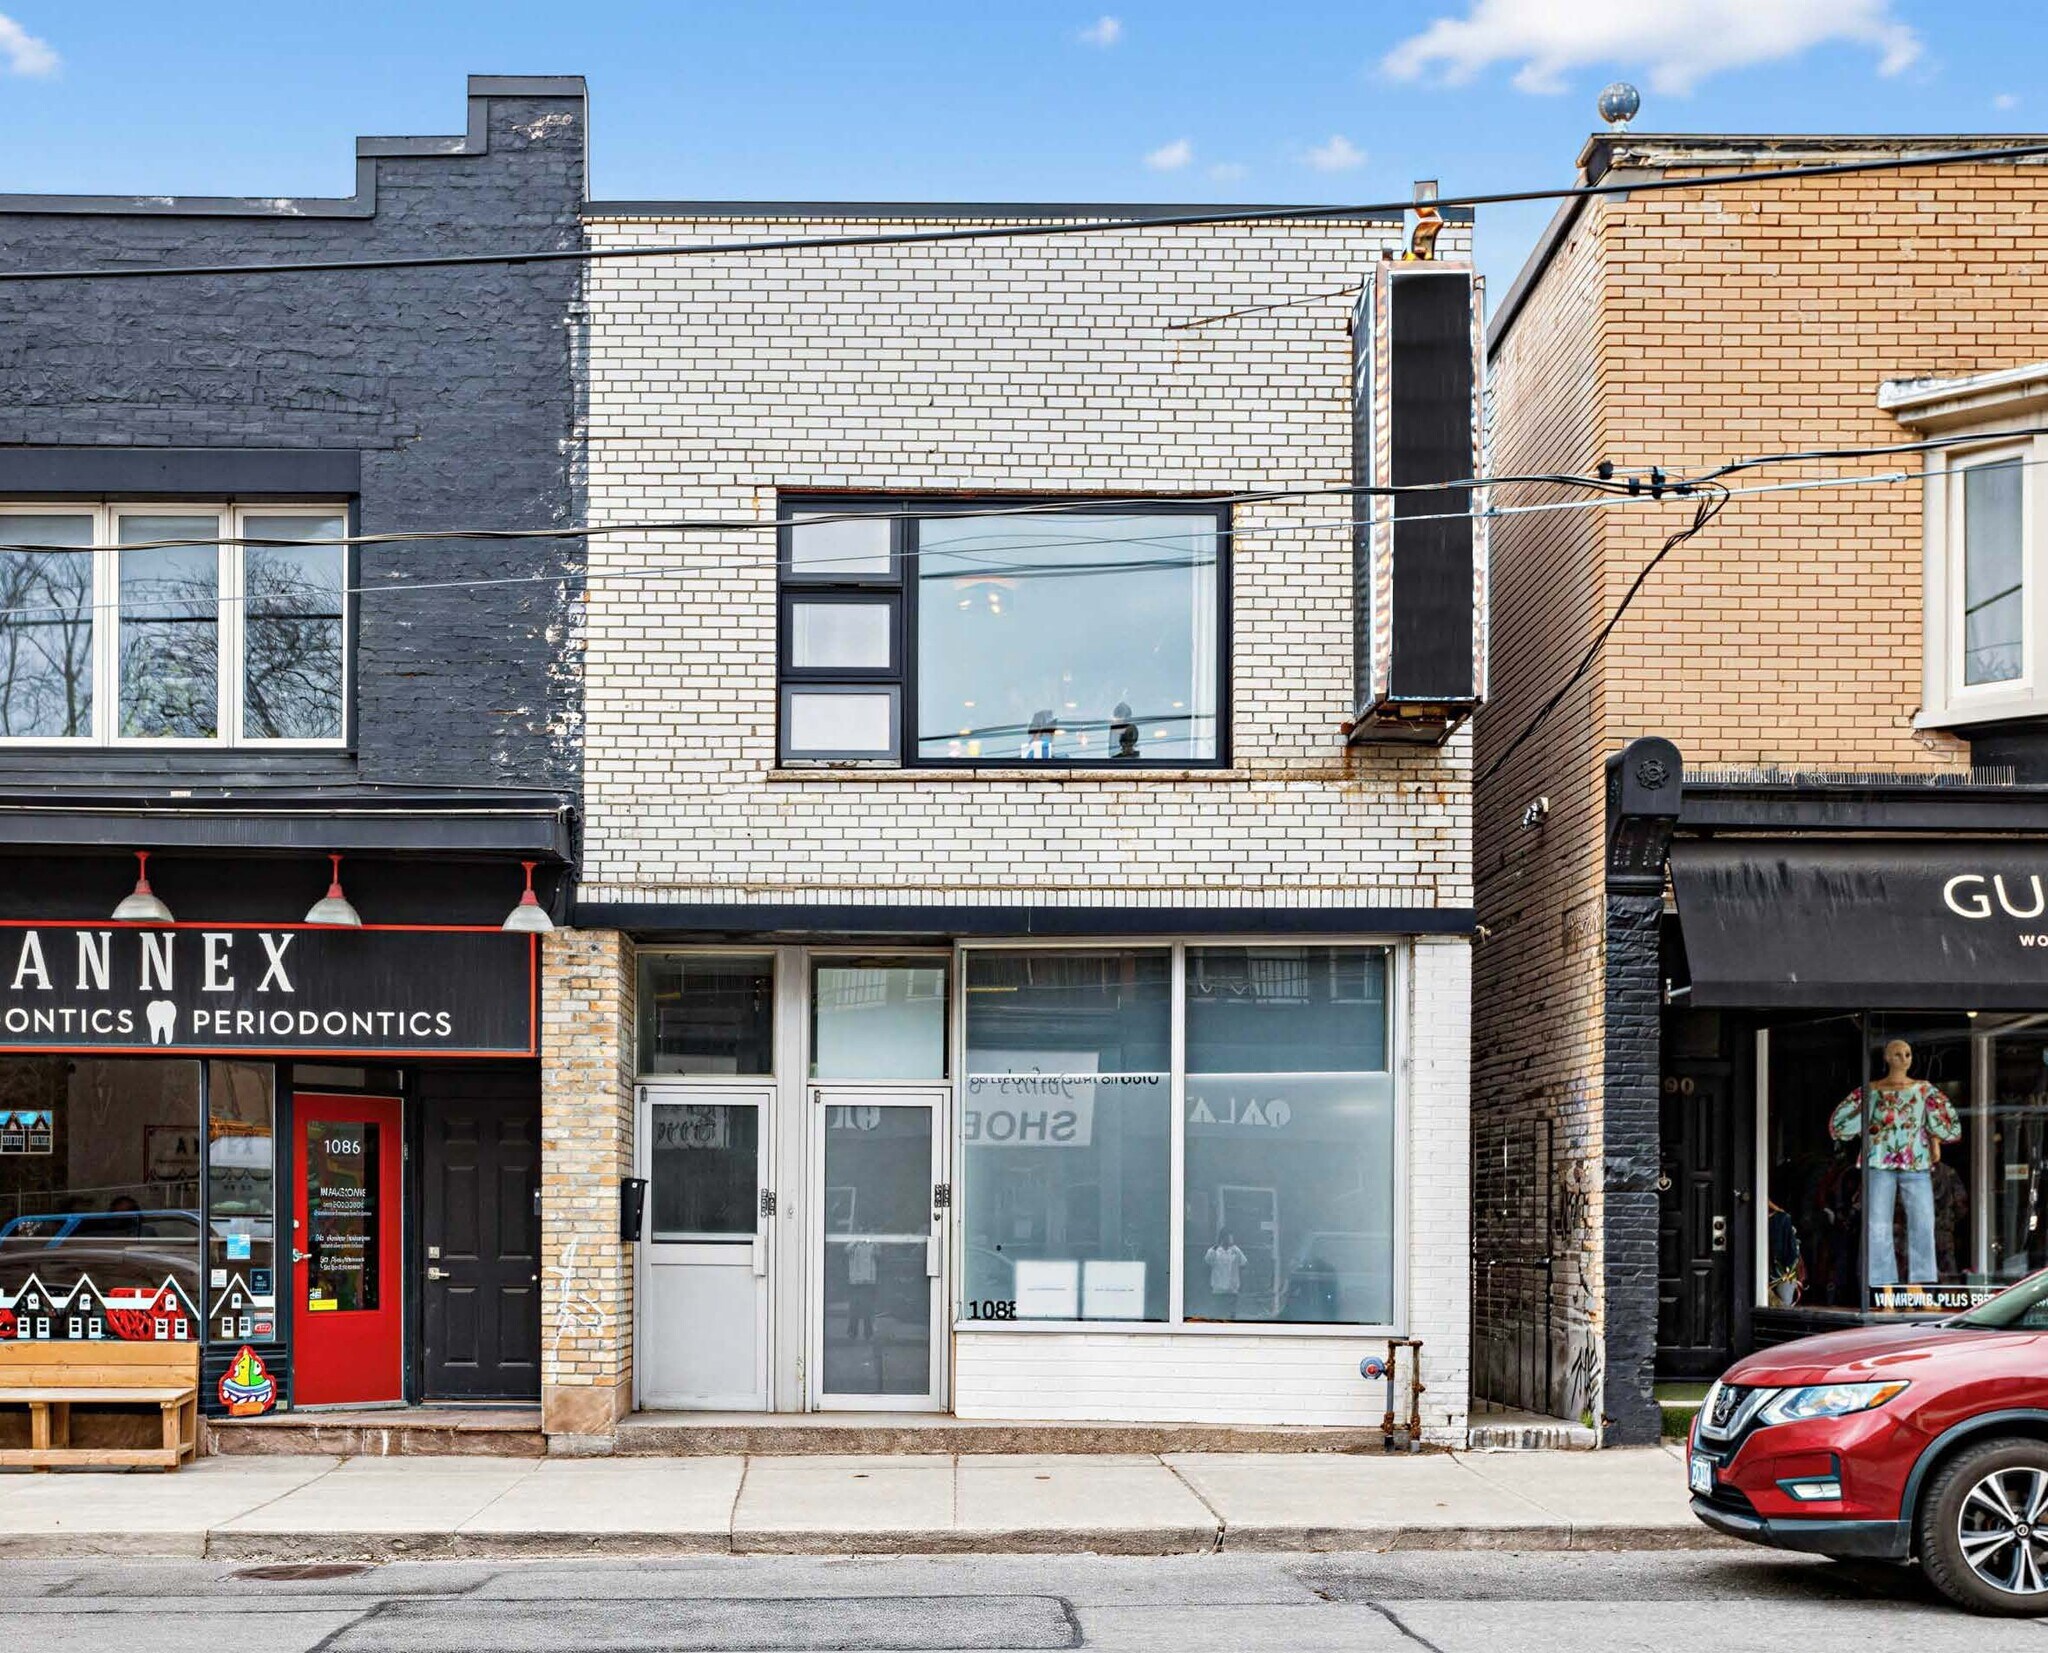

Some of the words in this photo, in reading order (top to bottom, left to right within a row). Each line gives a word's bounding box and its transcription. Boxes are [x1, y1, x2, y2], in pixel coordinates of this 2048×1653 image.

[1943, 874, 2045, 918] GU
[10, 931, 295, 992] ANNEX
[0, 1007, 134, 1033] ONTICS
[193, 1009, 452, 1036] PERIODONTICS
[324, 1139, 361, 1155] 1086
